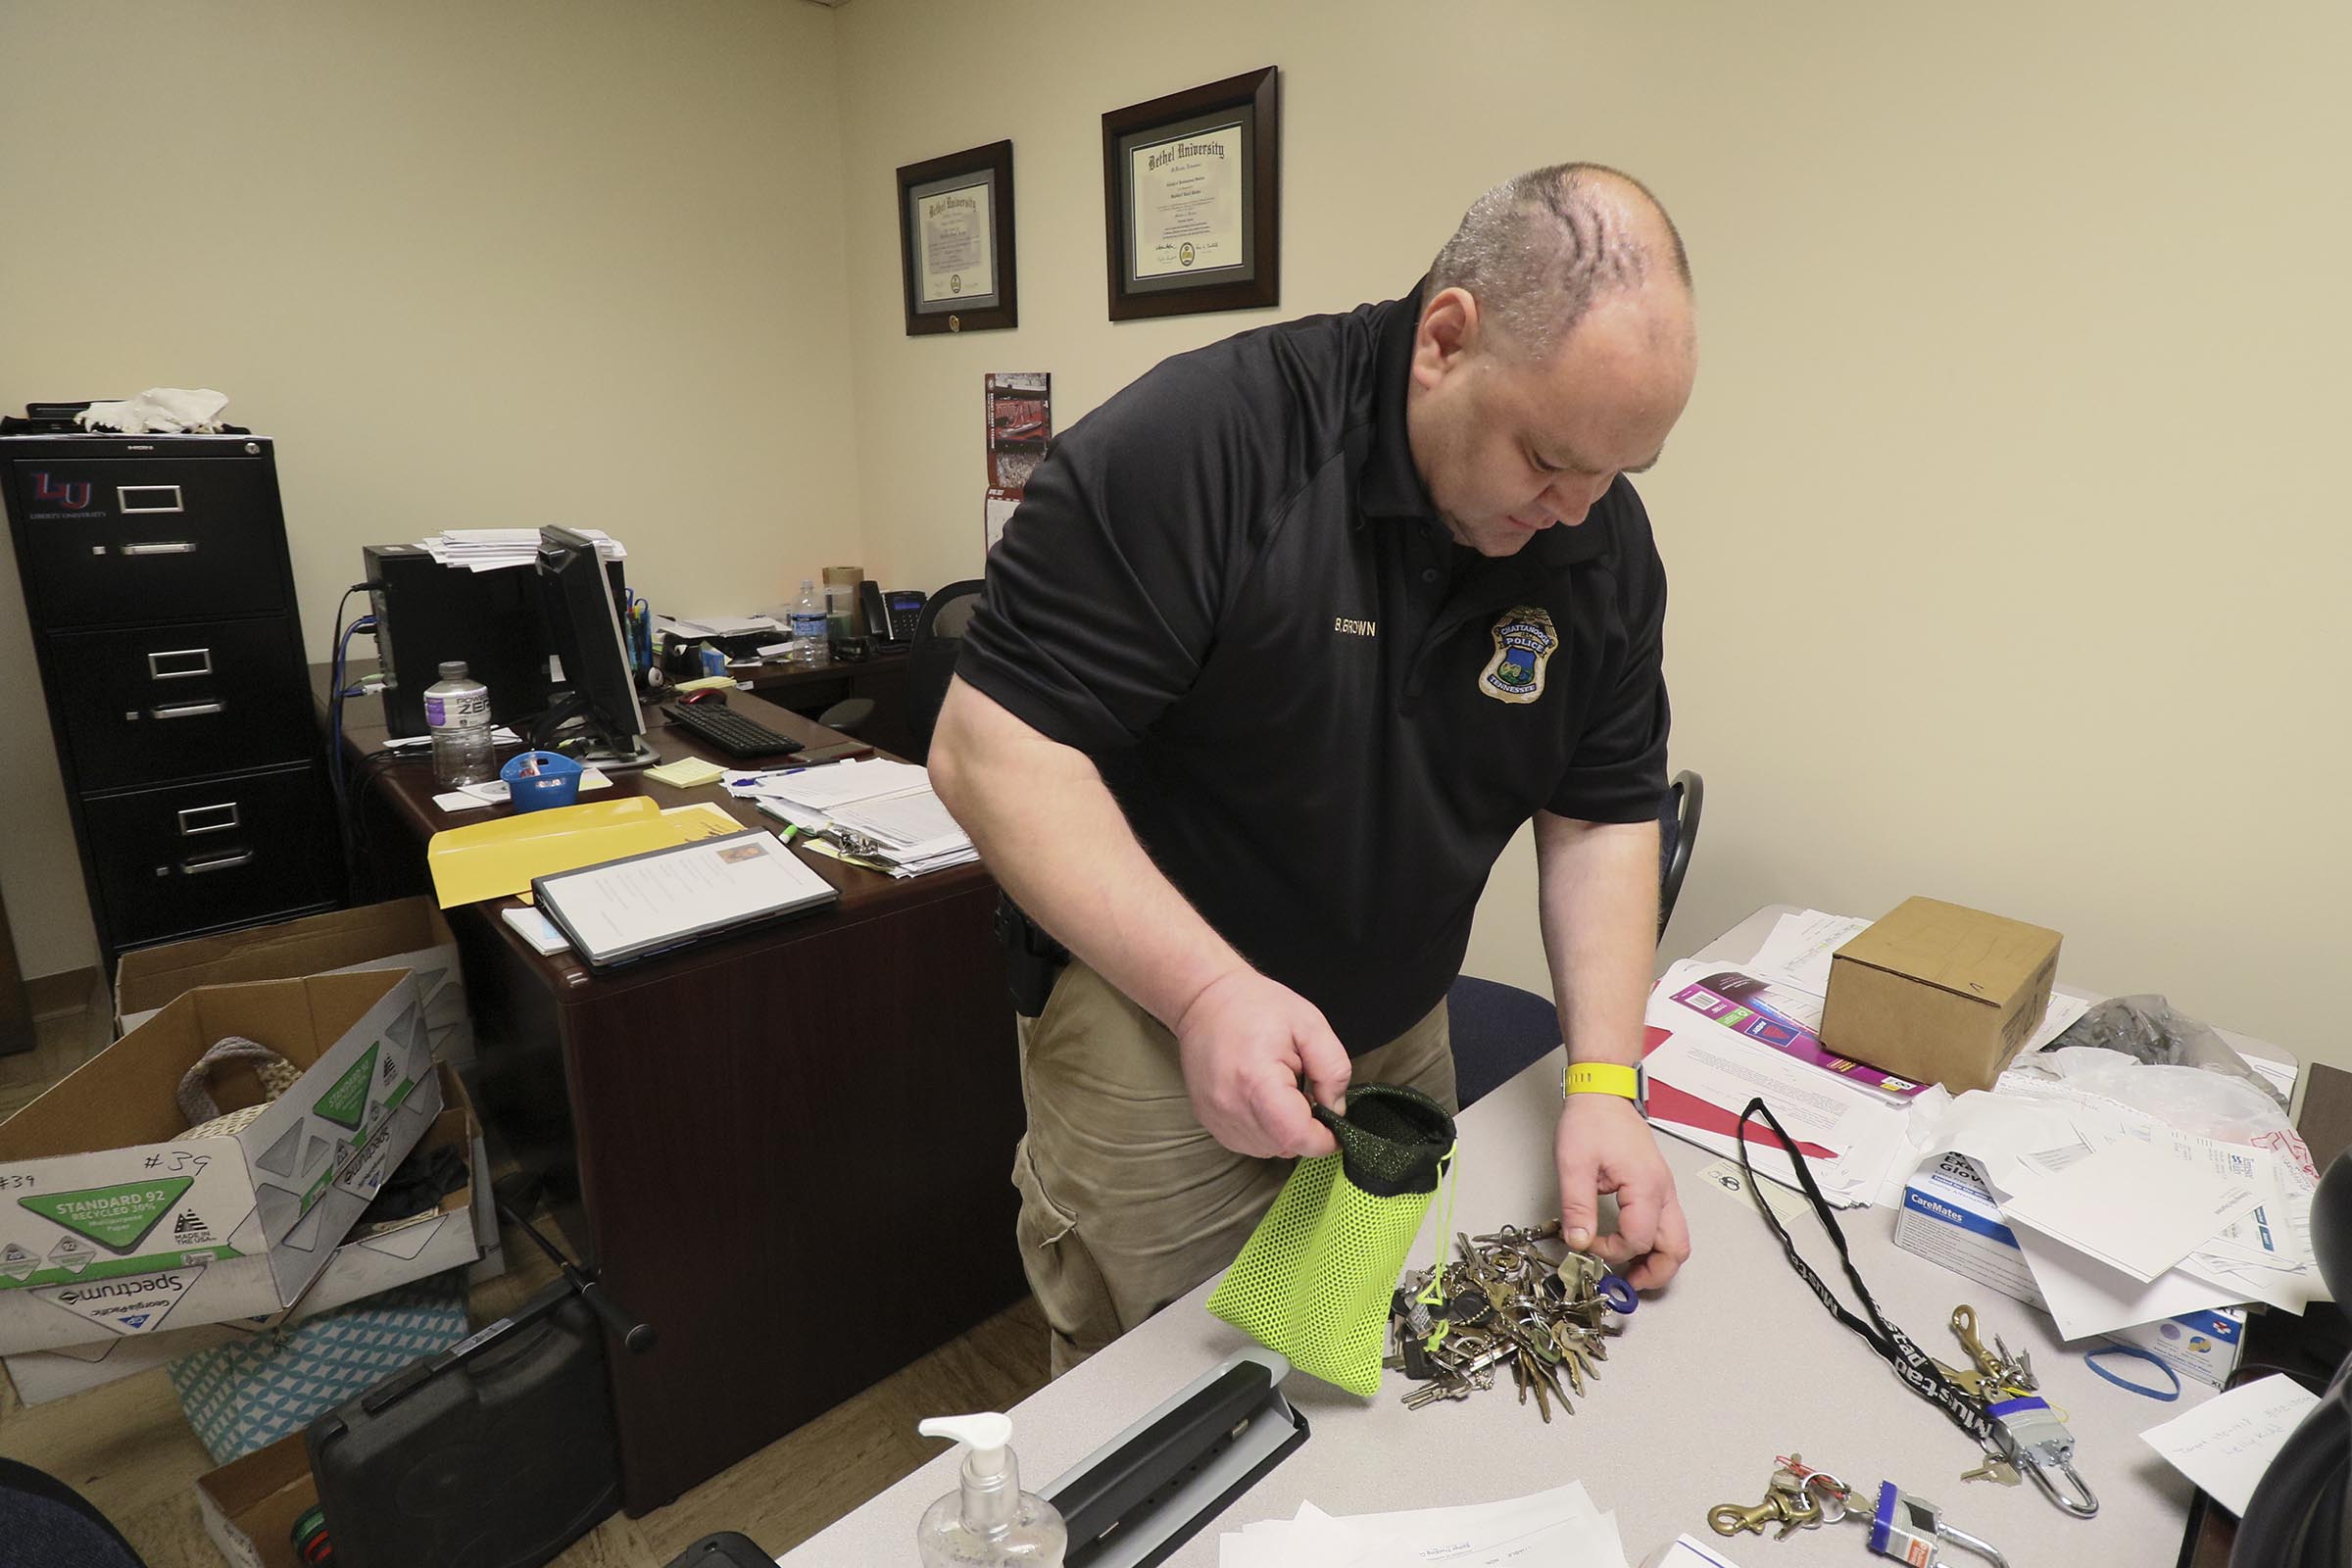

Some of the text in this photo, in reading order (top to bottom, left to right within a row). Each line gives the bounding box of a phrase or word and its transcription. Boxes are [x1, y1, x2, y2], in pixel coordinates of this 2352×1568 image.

[1148, 146, 1175, 172] Bethel
[1177, 140, 1225, 161] University
[30, 471, 90, 510] LU
[1334, 616, 1376, 637] B.BROWN
[1500, 624, 1550, 646] CHATTANOOGA
[1506, 638, 1545, 654] POLICE
[1489, 675, 1537, 694] TENNESSEE
[56, 1190, 166, 1215] STANDARD 92
[72, 1206, 128, 1221] RECYCLED
[1911, 1194, 1964, 1222] CareMates
[79, 1274, 183, 1302] Spectrum
